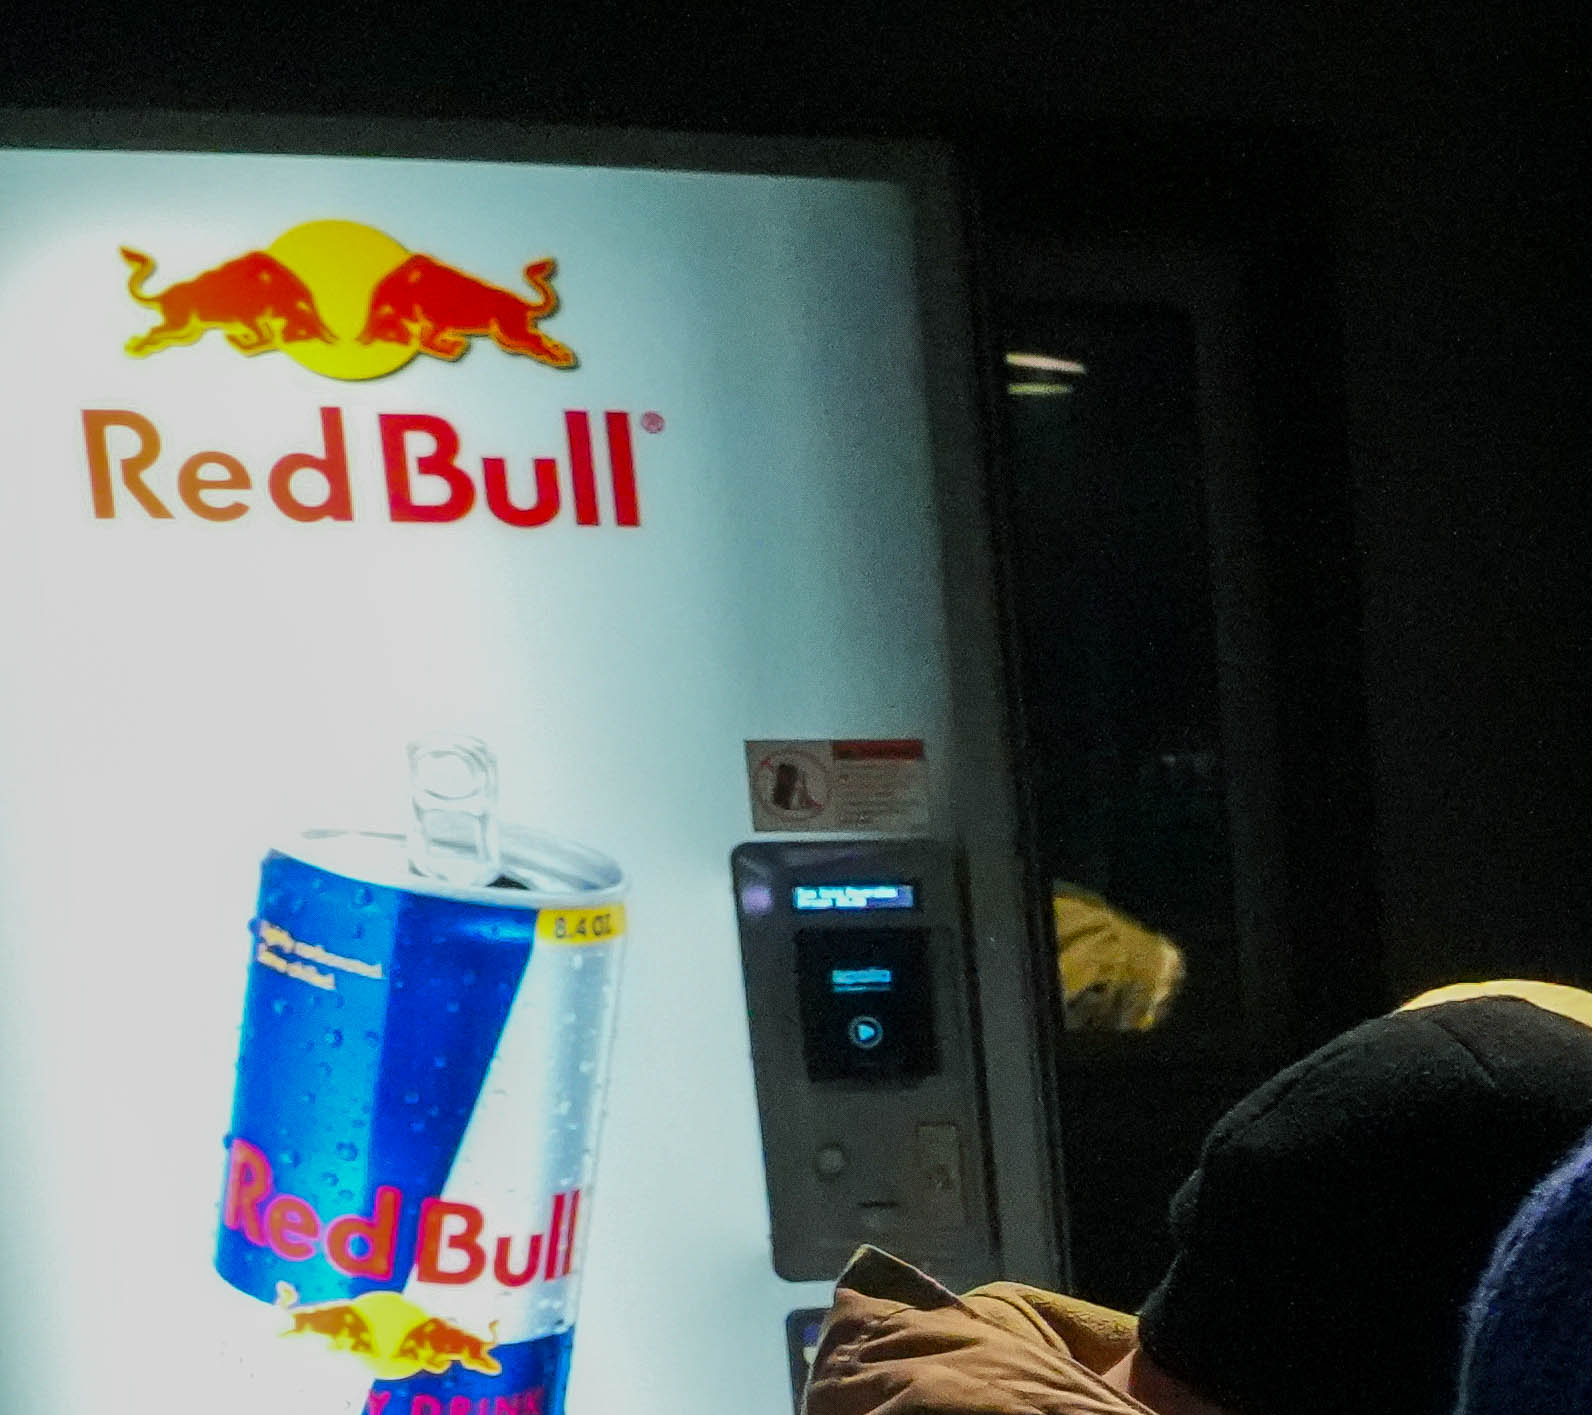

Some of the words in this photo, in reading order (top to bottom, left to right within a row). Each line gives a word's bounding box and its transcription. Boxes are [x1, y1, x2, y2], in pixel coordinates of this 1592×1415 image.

[81, 405, 354, 522] Red
[377, 409, 642, 528] Bull
[223, 1136, 403, 1282] Red
[416, 1189, 578, 1288] Bull
